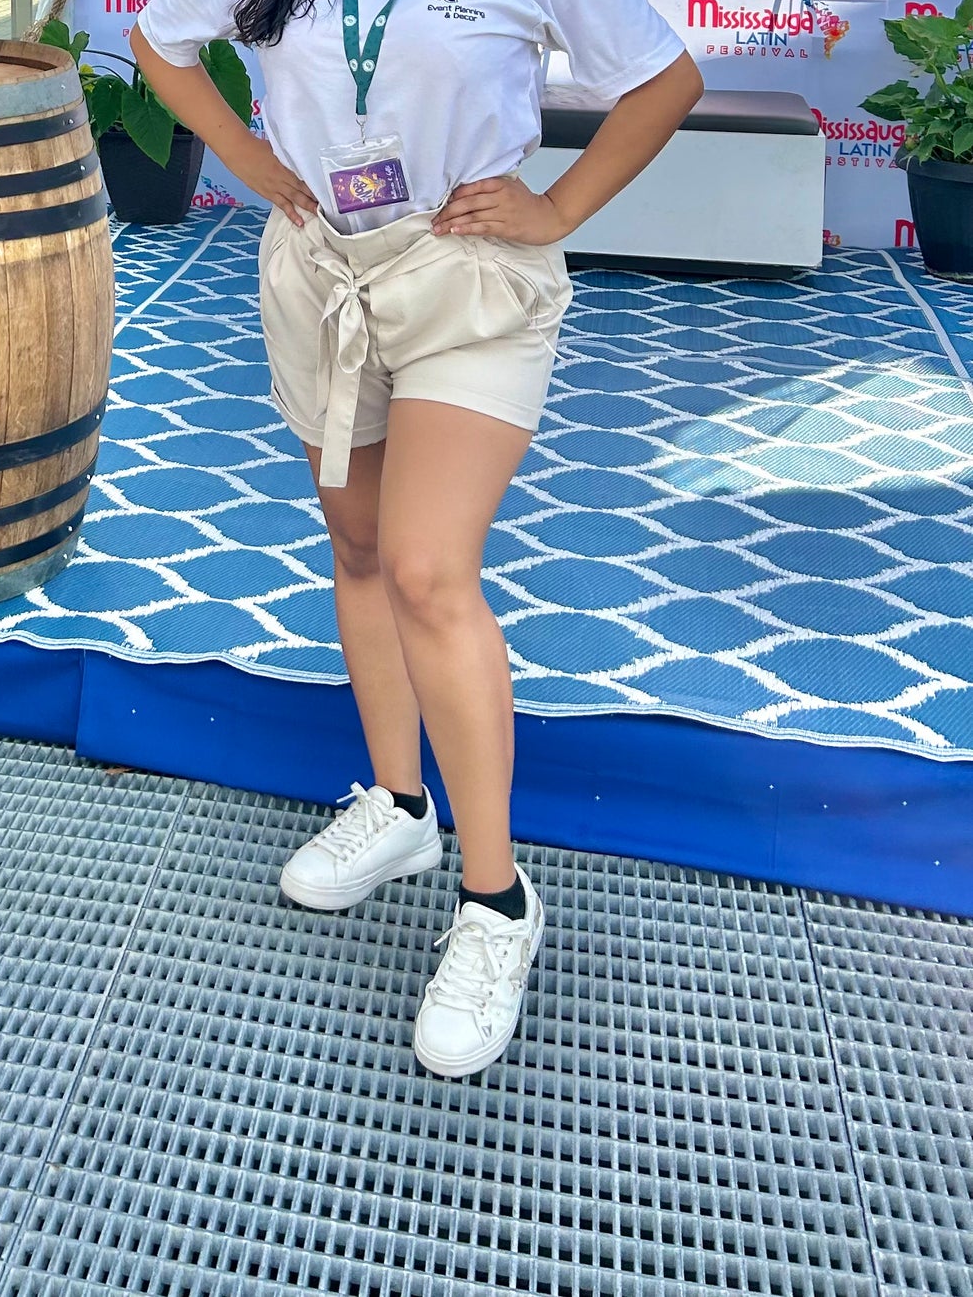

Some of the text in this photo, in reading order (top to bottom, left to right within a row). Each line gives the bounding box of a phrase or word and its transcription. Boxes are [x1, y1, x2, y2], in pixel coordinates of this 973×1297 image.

[427, 4, 486, 19] Event Planning
[444, 11, 478, 22] & Decor
[735, 31, 788, 46] LATIN
[706, 45, 809, 59] FESTIVAL
[810, 107, 906, 148] ississaug
[839, 142, 892, 157] LATIN
[824, 155, 899, 169] ESTIVA
